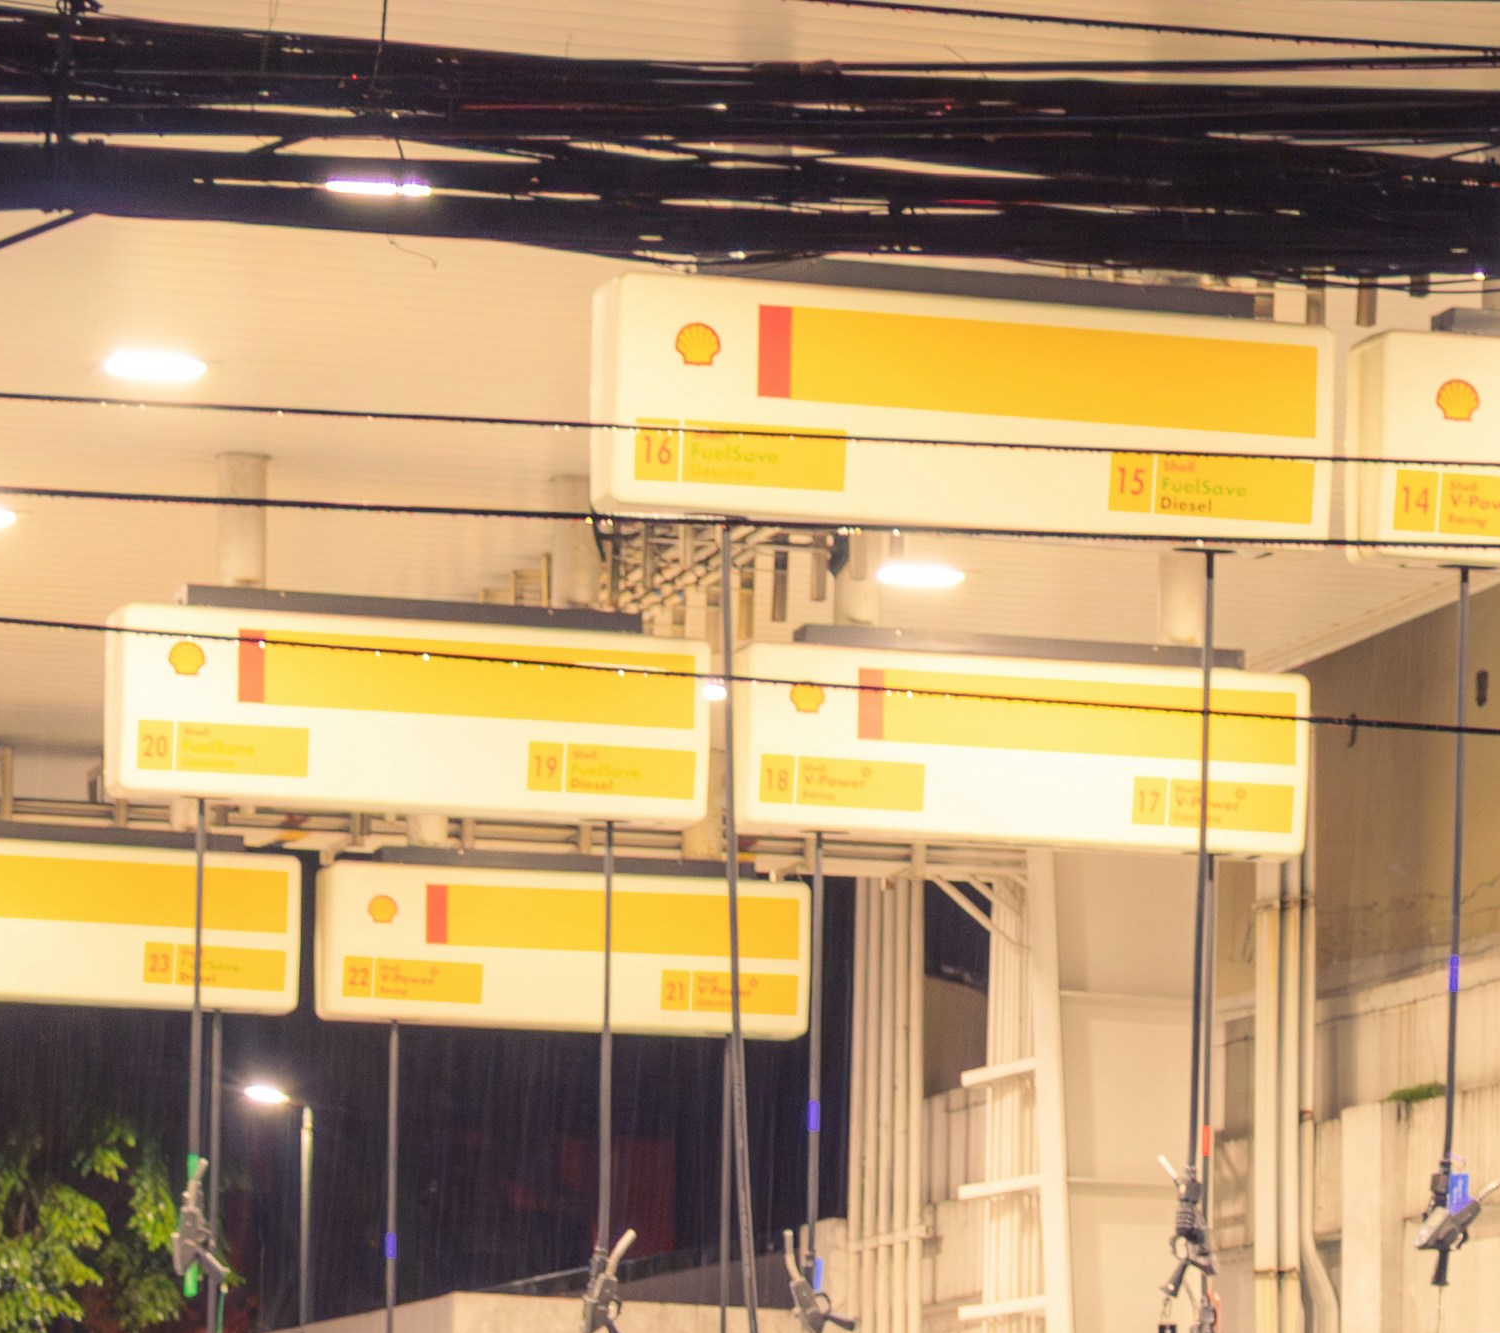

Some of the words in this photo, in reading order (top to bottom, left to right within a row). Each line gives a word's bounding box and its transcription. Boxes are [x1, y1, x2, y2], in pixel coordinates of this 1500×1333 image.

[644, 435, 671, 464] 16
[691, 443, 779, 463] FuelSave
[1117, 467, 1145, 495] 15
[1162, 477, 1246, 497] FuelSave
[1161, 497, 1212, 513] Diesel
[1402, 485, 1430, 514] 14
[143, 734, 168, 757] 20
[535, 755, 557, 778] 19
[766, 768, 789, 791] 18
[804, 775, 866, 788] V-Power
[1138, 790, 1161, 812] 17
[149, 953, 169, 973] 23
[349, 965, 369, 986] 22
[666, 982, 684, 1001] 21
